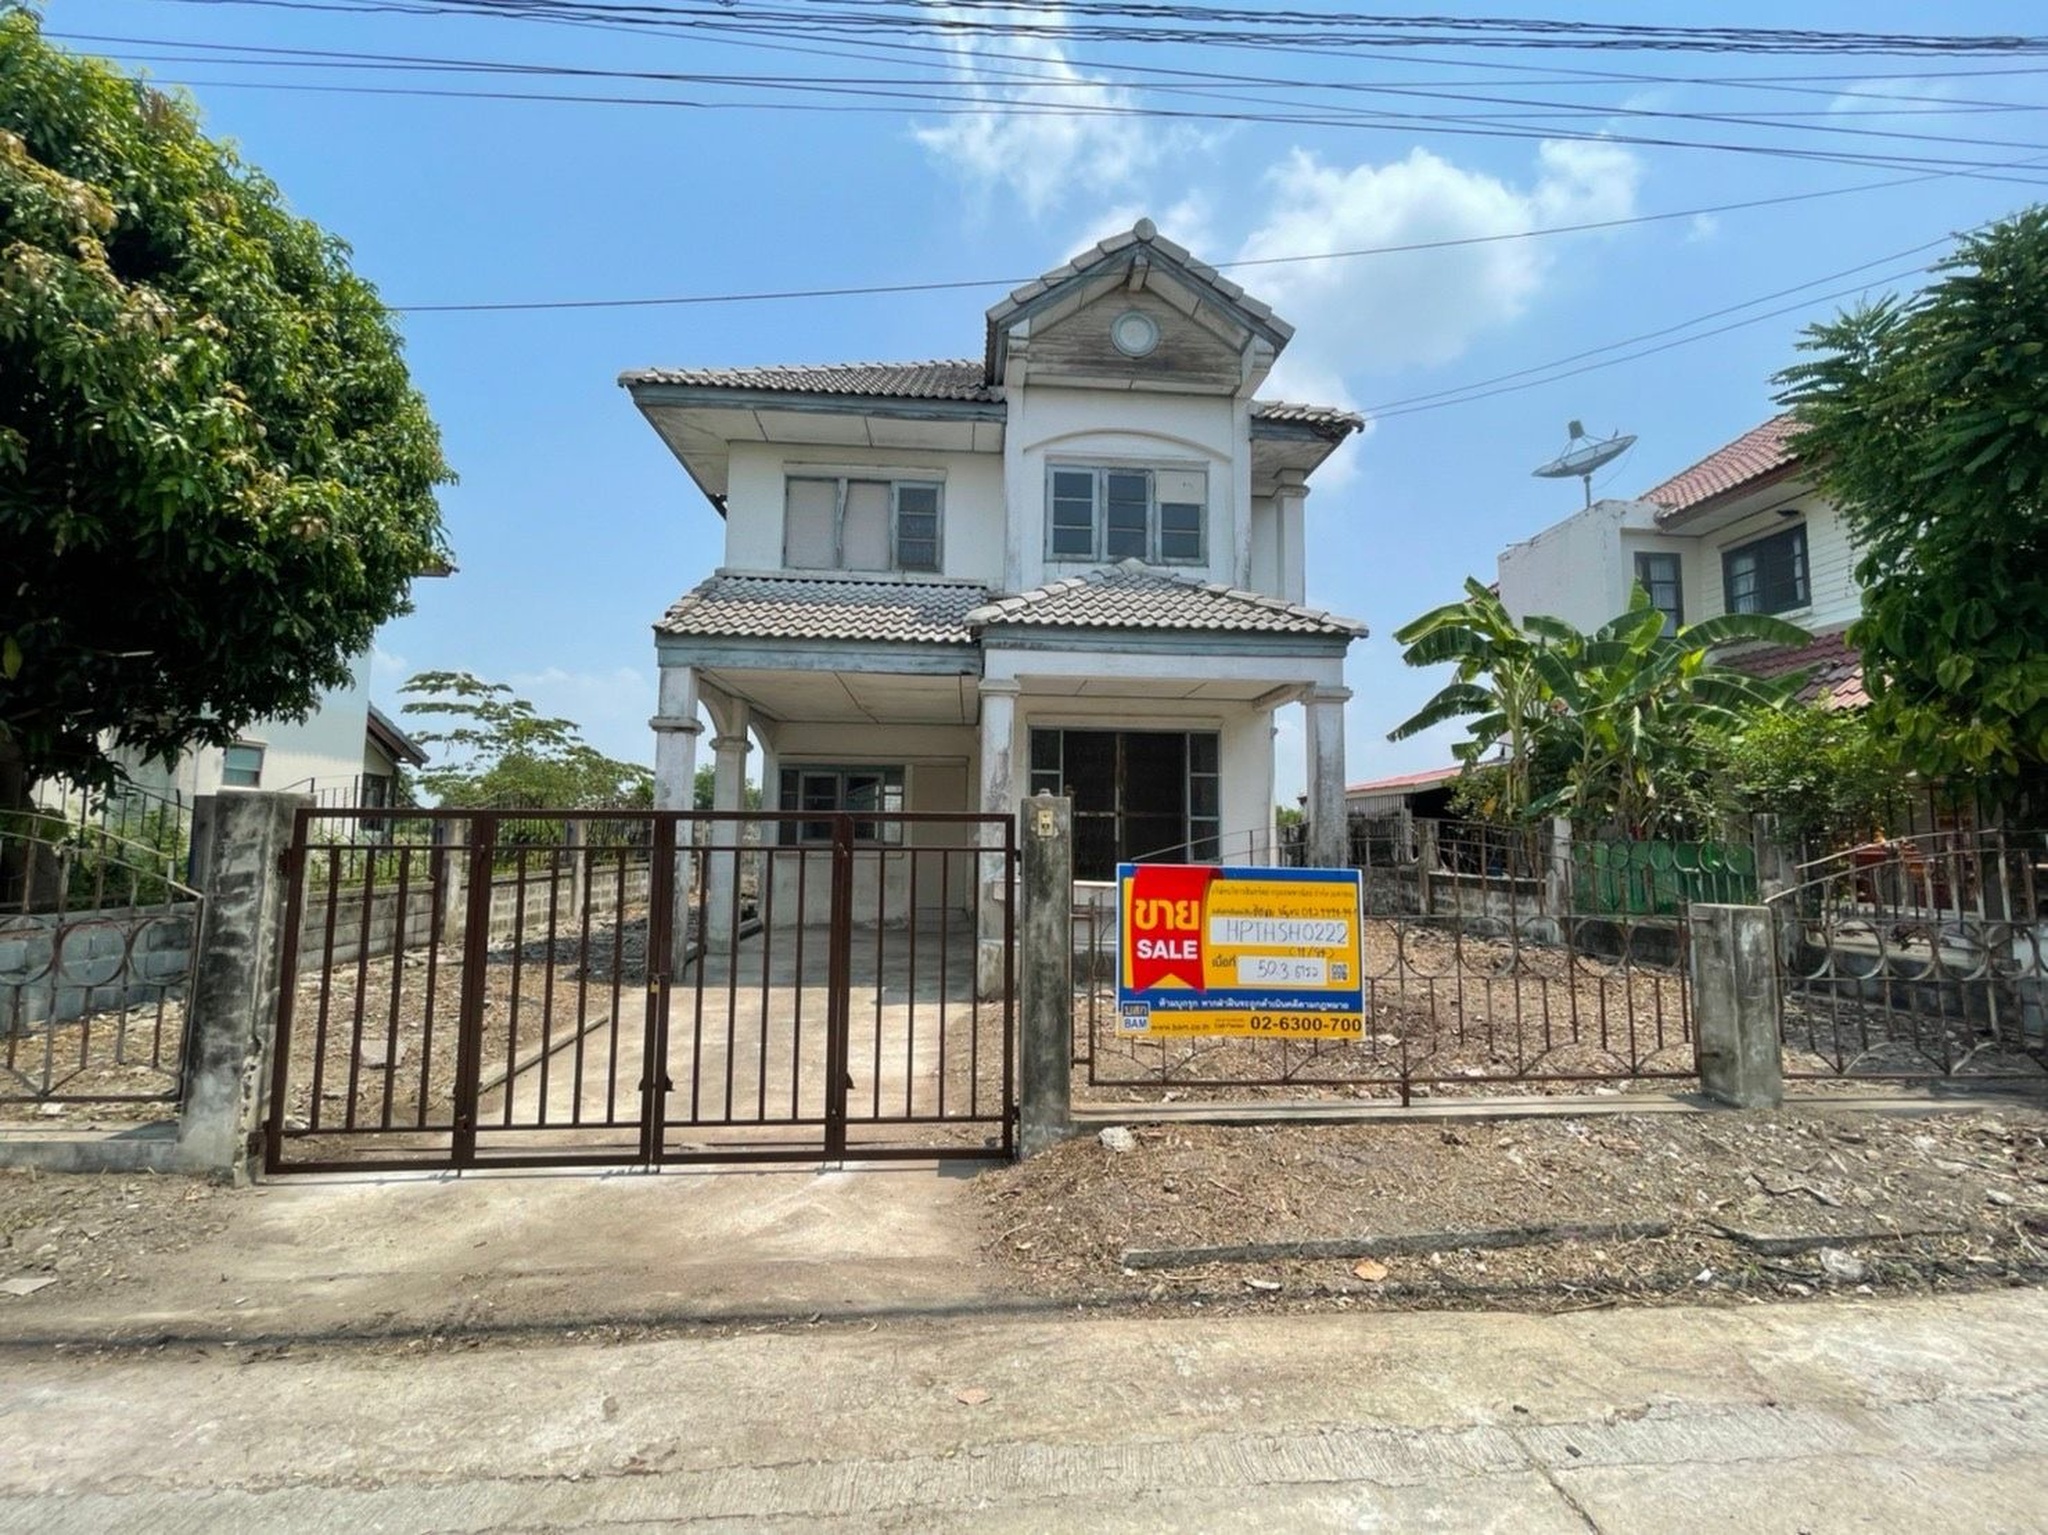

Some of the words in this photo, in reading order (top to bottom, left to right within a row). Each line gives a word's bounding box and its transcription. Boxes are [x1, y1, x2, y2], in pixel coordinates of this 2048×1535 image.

[1135, 899, 1200, 930] ขาย
[1136, 939, 1199, 960] SALE
[1124, 1018, 1148, 1030] BAM
[1250, 1016, 1363, 1032] 02-6300-700
